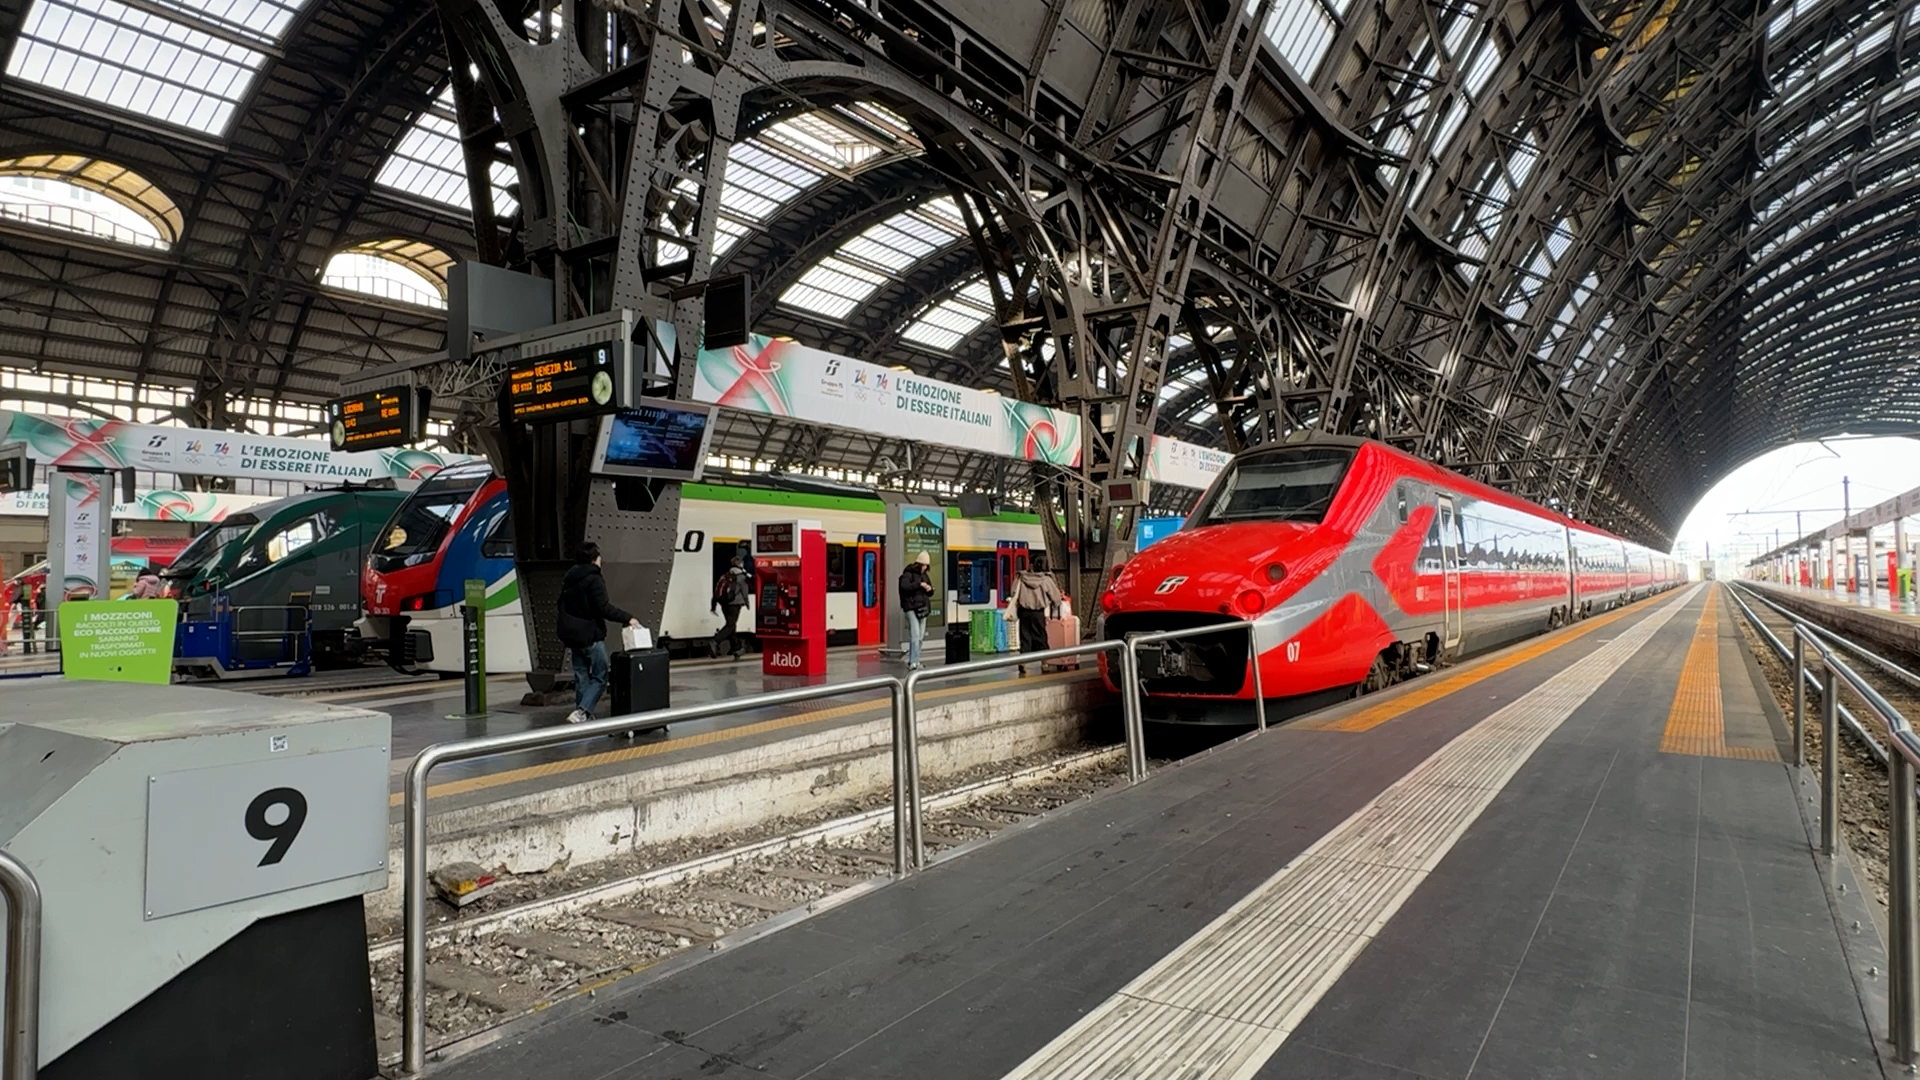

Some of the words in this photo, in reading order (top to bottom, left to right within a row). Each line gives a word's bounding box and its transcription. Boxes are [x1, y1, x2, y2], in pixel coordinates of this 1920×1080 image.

[598, 349, 606, 365] 9
[535, 363, 561, 377] VENEZIA
[896, 377, 962, 405] L'EMOZIONE
[896, 396, 908, 410] DI
[911, 398, 948, 419] ESSERE
[950, 407, 992, 428] ITALIANI
[241, 444, 331, 462] L'EMOZIONE
[241, 459, 257, 469] DI
[260, 460, 312, 474] ESSERE
[314, 463, 373, 478] ITALIANI
[32, 501, 49, 509] ES
[906, 526, 941, 535] STARLINK
[90, 611, 153, 621] MOZZICONI
[76, 621, 116, 629] RACCOLTI
[127, 619, 160, 627] QUESTO
[74, 629, 94, 637] ECO
[95, 626, 162, 636] RACCOGLITORE
[90, 641, 144, 650] TRASFORMATI
[98, 635, 140, 643] SARANNO
[90, 650, 117, 658] NUOVI
[1287, 640, 1300, 663] 07
[770, 651, 802, 668] italo
[245, 786, 309, 869] 9
